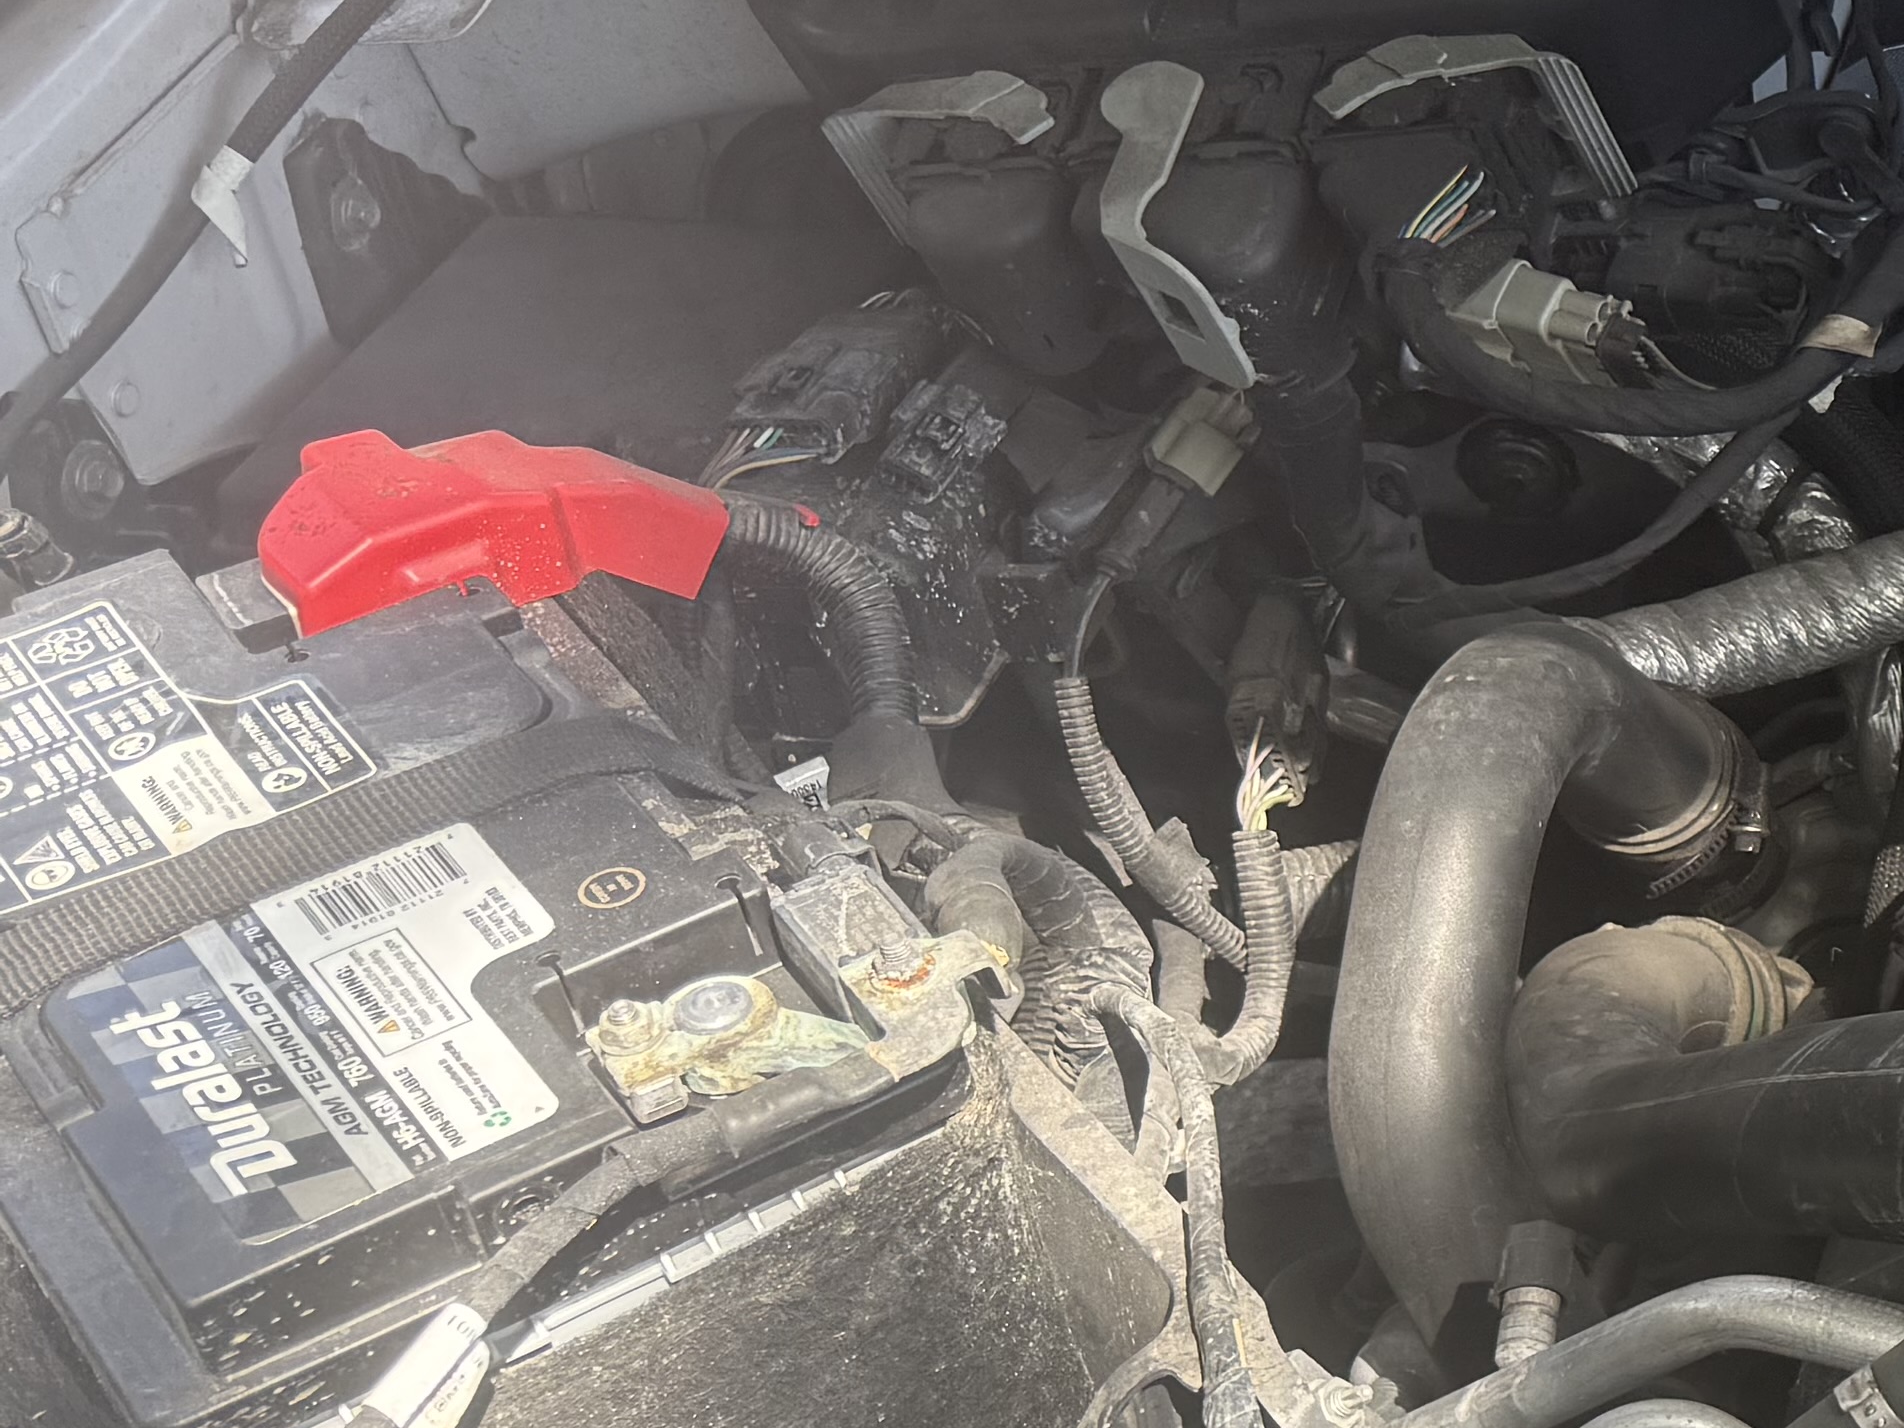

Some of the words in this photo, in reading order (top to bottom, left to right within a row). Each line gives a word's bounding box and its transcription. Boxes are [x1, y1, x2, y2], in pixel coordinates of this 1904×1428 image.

[270, 701, 340, 774] NON-SPILLABLE
[141, 775, 185, 825] WARNING:
[242, 925, 264, 943] 70
[303, 1003, 330, 1026] 950
[336, 964, 389, 1024] WARNING:
[185, 986, 280, 1095] PLATINUM
[231, 982, 331, 1094] TECHNOLOGY
[111, 1001, 293, 1194] Duralast
[336, 1055, 374, 1087] 760
[320, 1095, 368, 1135] AGM
[364, 1089, 424, 1149] H6-AGM
[392, 1066, 465, 1148] NON-SPILLABLE
